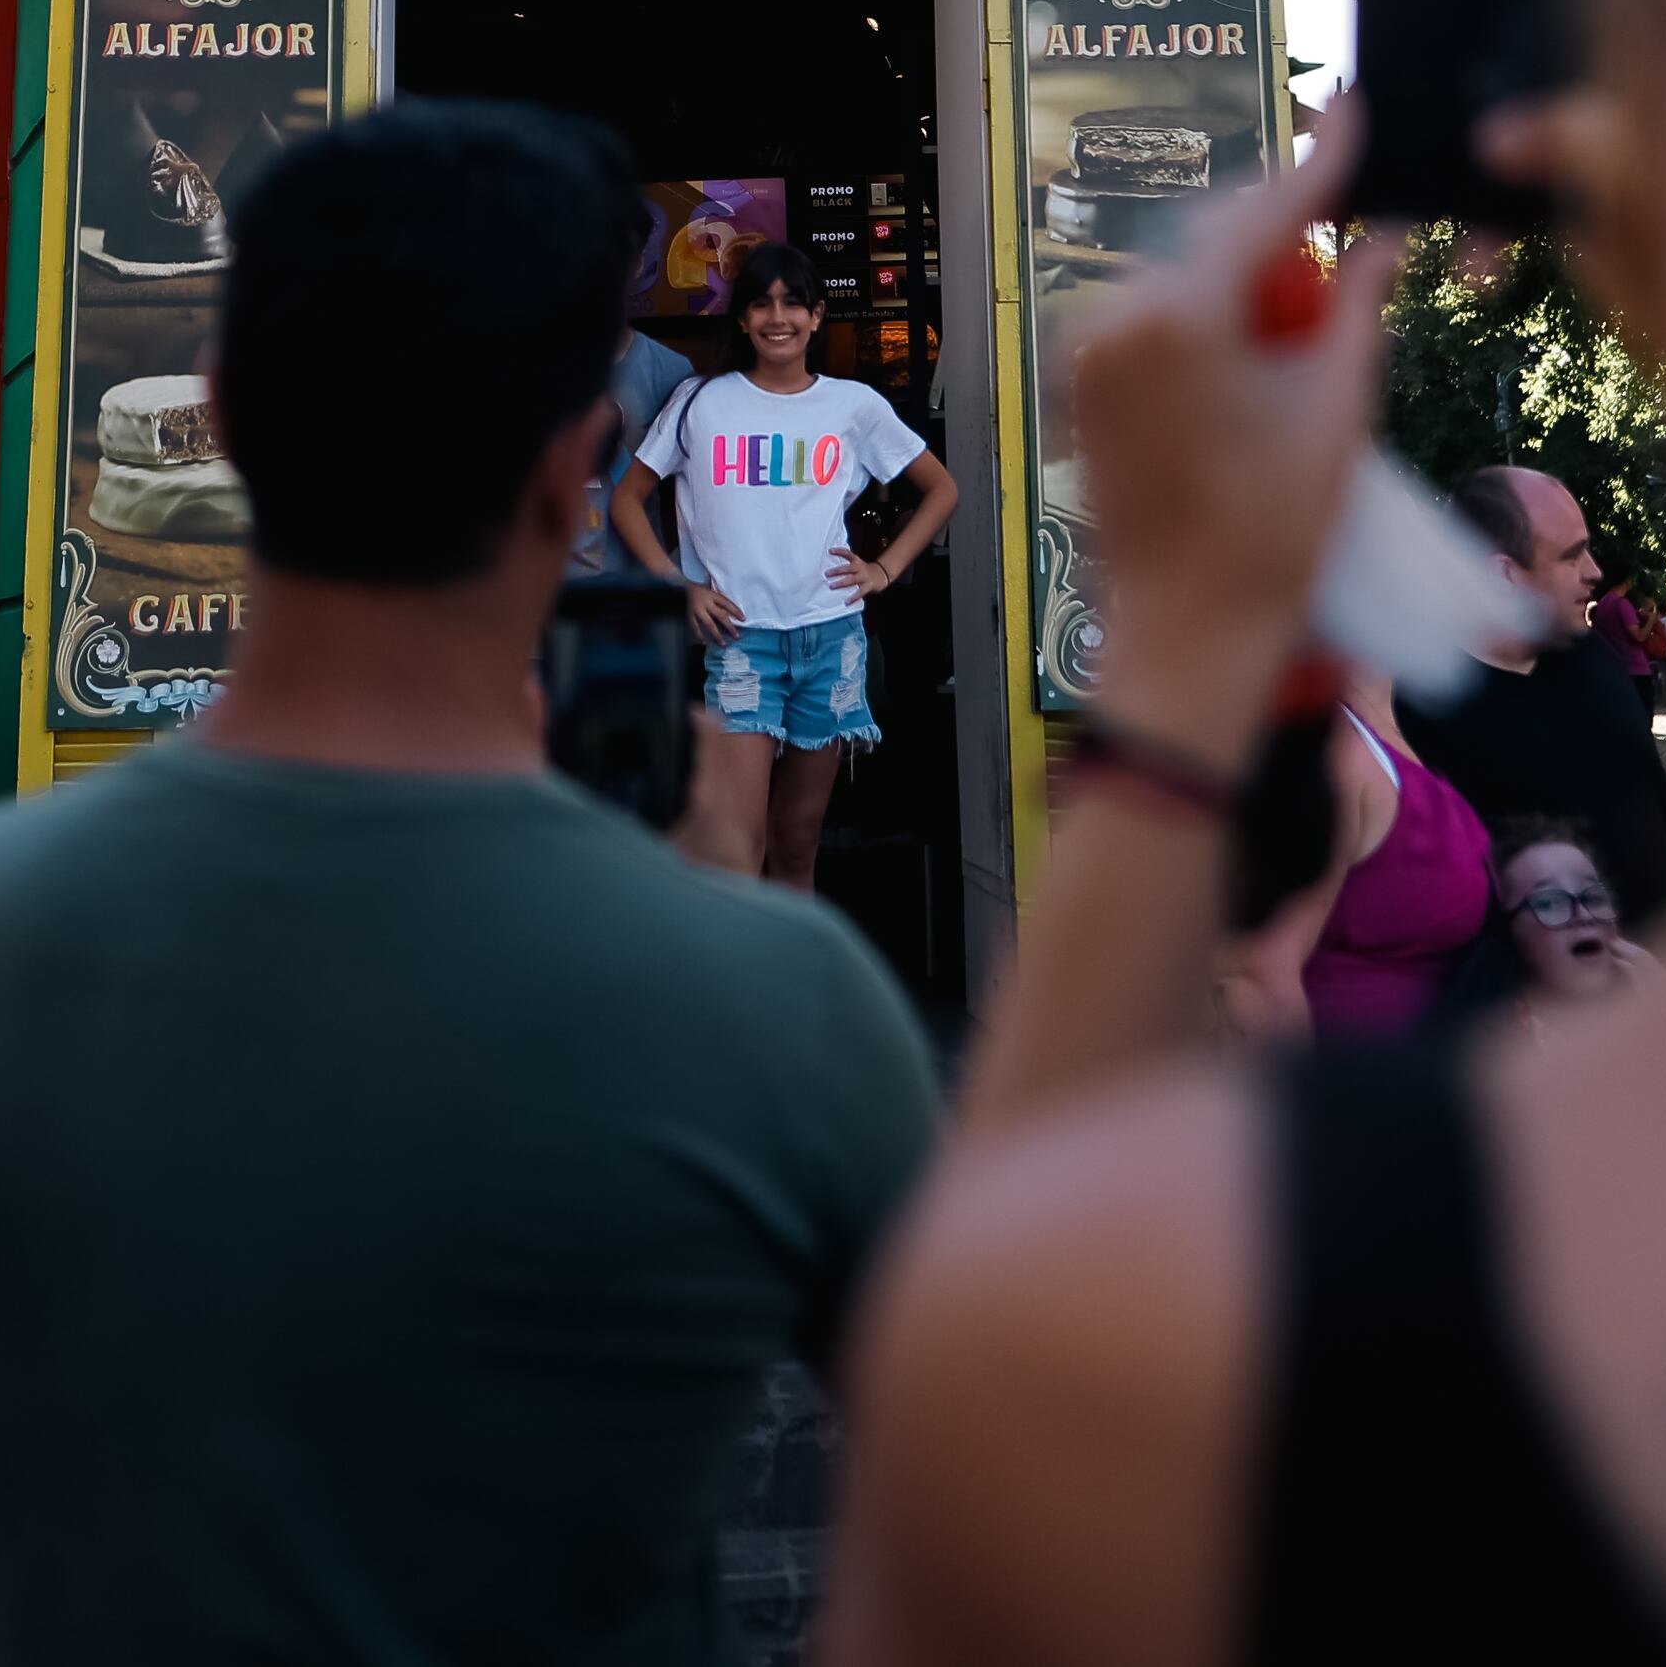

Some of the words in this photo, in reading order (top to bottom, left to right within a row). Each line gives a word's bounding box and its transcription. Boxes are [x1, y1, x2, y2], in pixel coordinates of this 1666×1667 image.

[102, 22, 315, 57] ALFAJOR
[1044, 23, 1246, 57] ALFAJOR
[810, 186, 854, 196] PROMO
[813, 197, 852, 207] BLACK
[812, 232, 855, 242] PROMO
[824, 244, 844, 252] VIP
[822, 278, 857, 287] ROMO
[712, 433, 841, 487] HELLO
